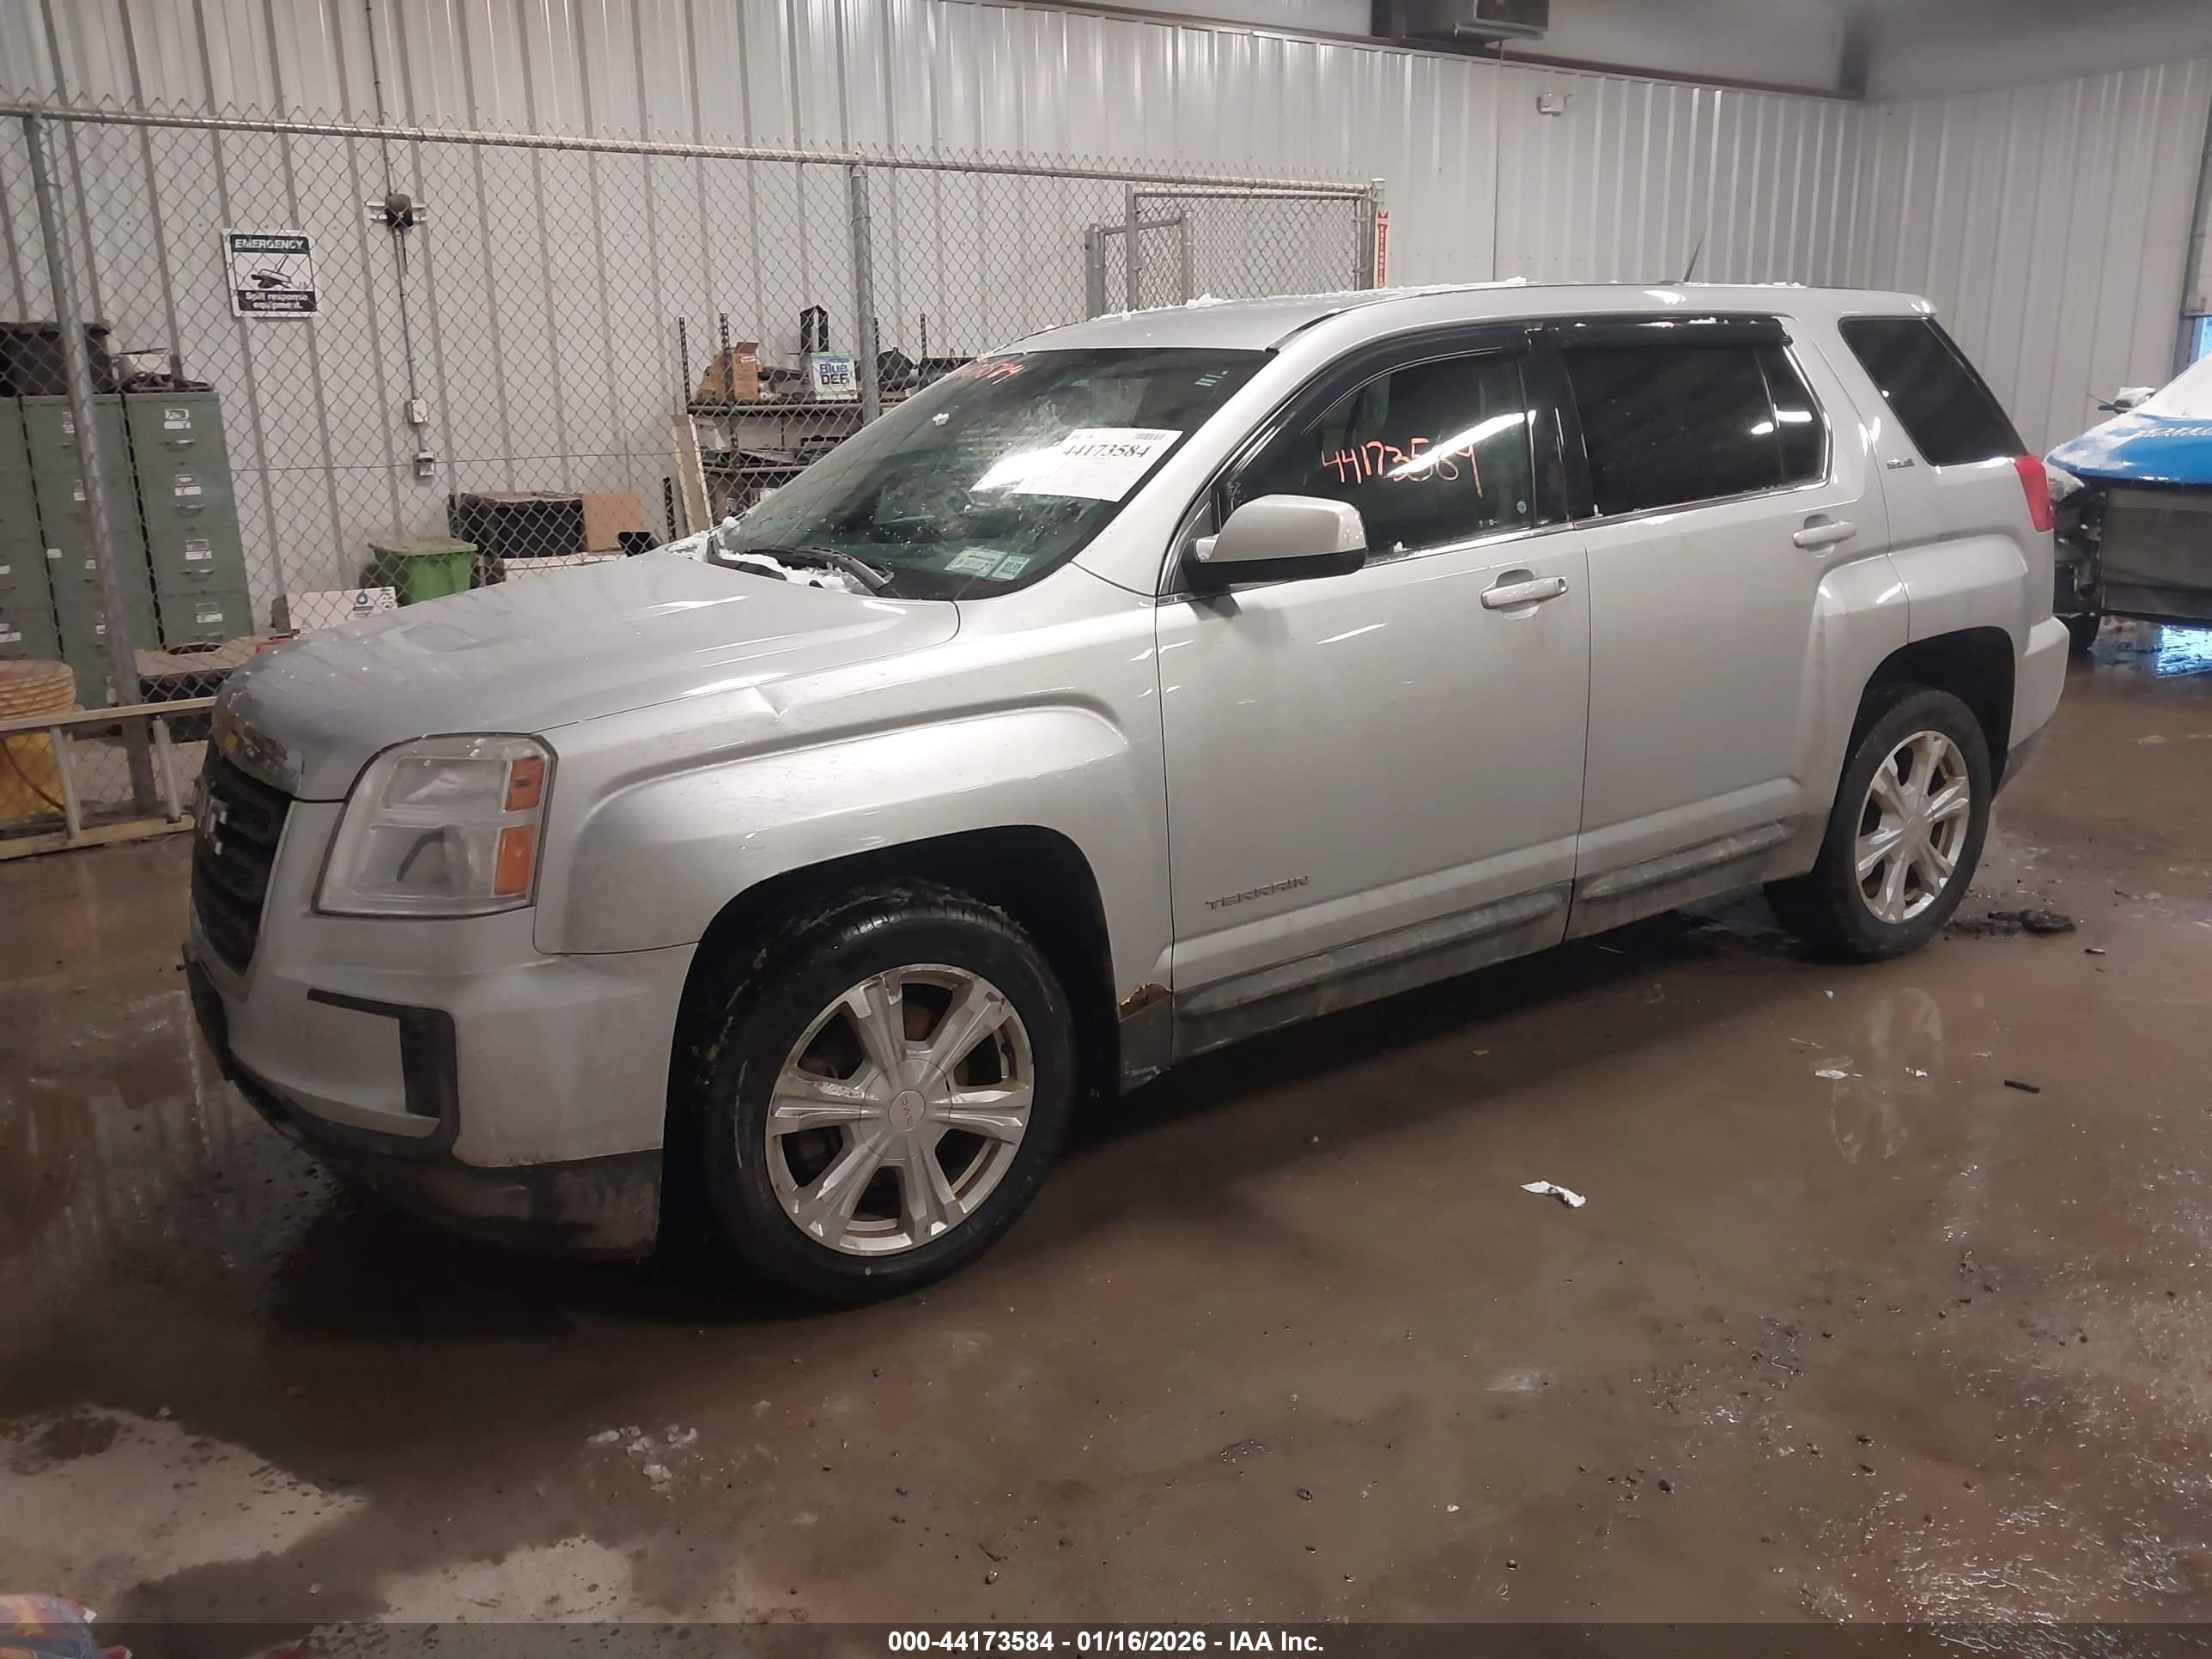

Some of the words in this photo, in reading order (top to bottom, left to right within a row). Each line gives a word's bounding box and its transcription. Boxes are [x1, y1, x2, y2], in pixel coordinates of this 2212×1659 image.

[234, 239, 304, 249] EMERGENCY
[267, 294, 309, 302] response
[819, 362, 848, 374] Blue
[821, 374, 849, 386] DEF
[1062, 444, 1152, 458] 44173584
[1205, 875, 1309, 910] TERRAIN
